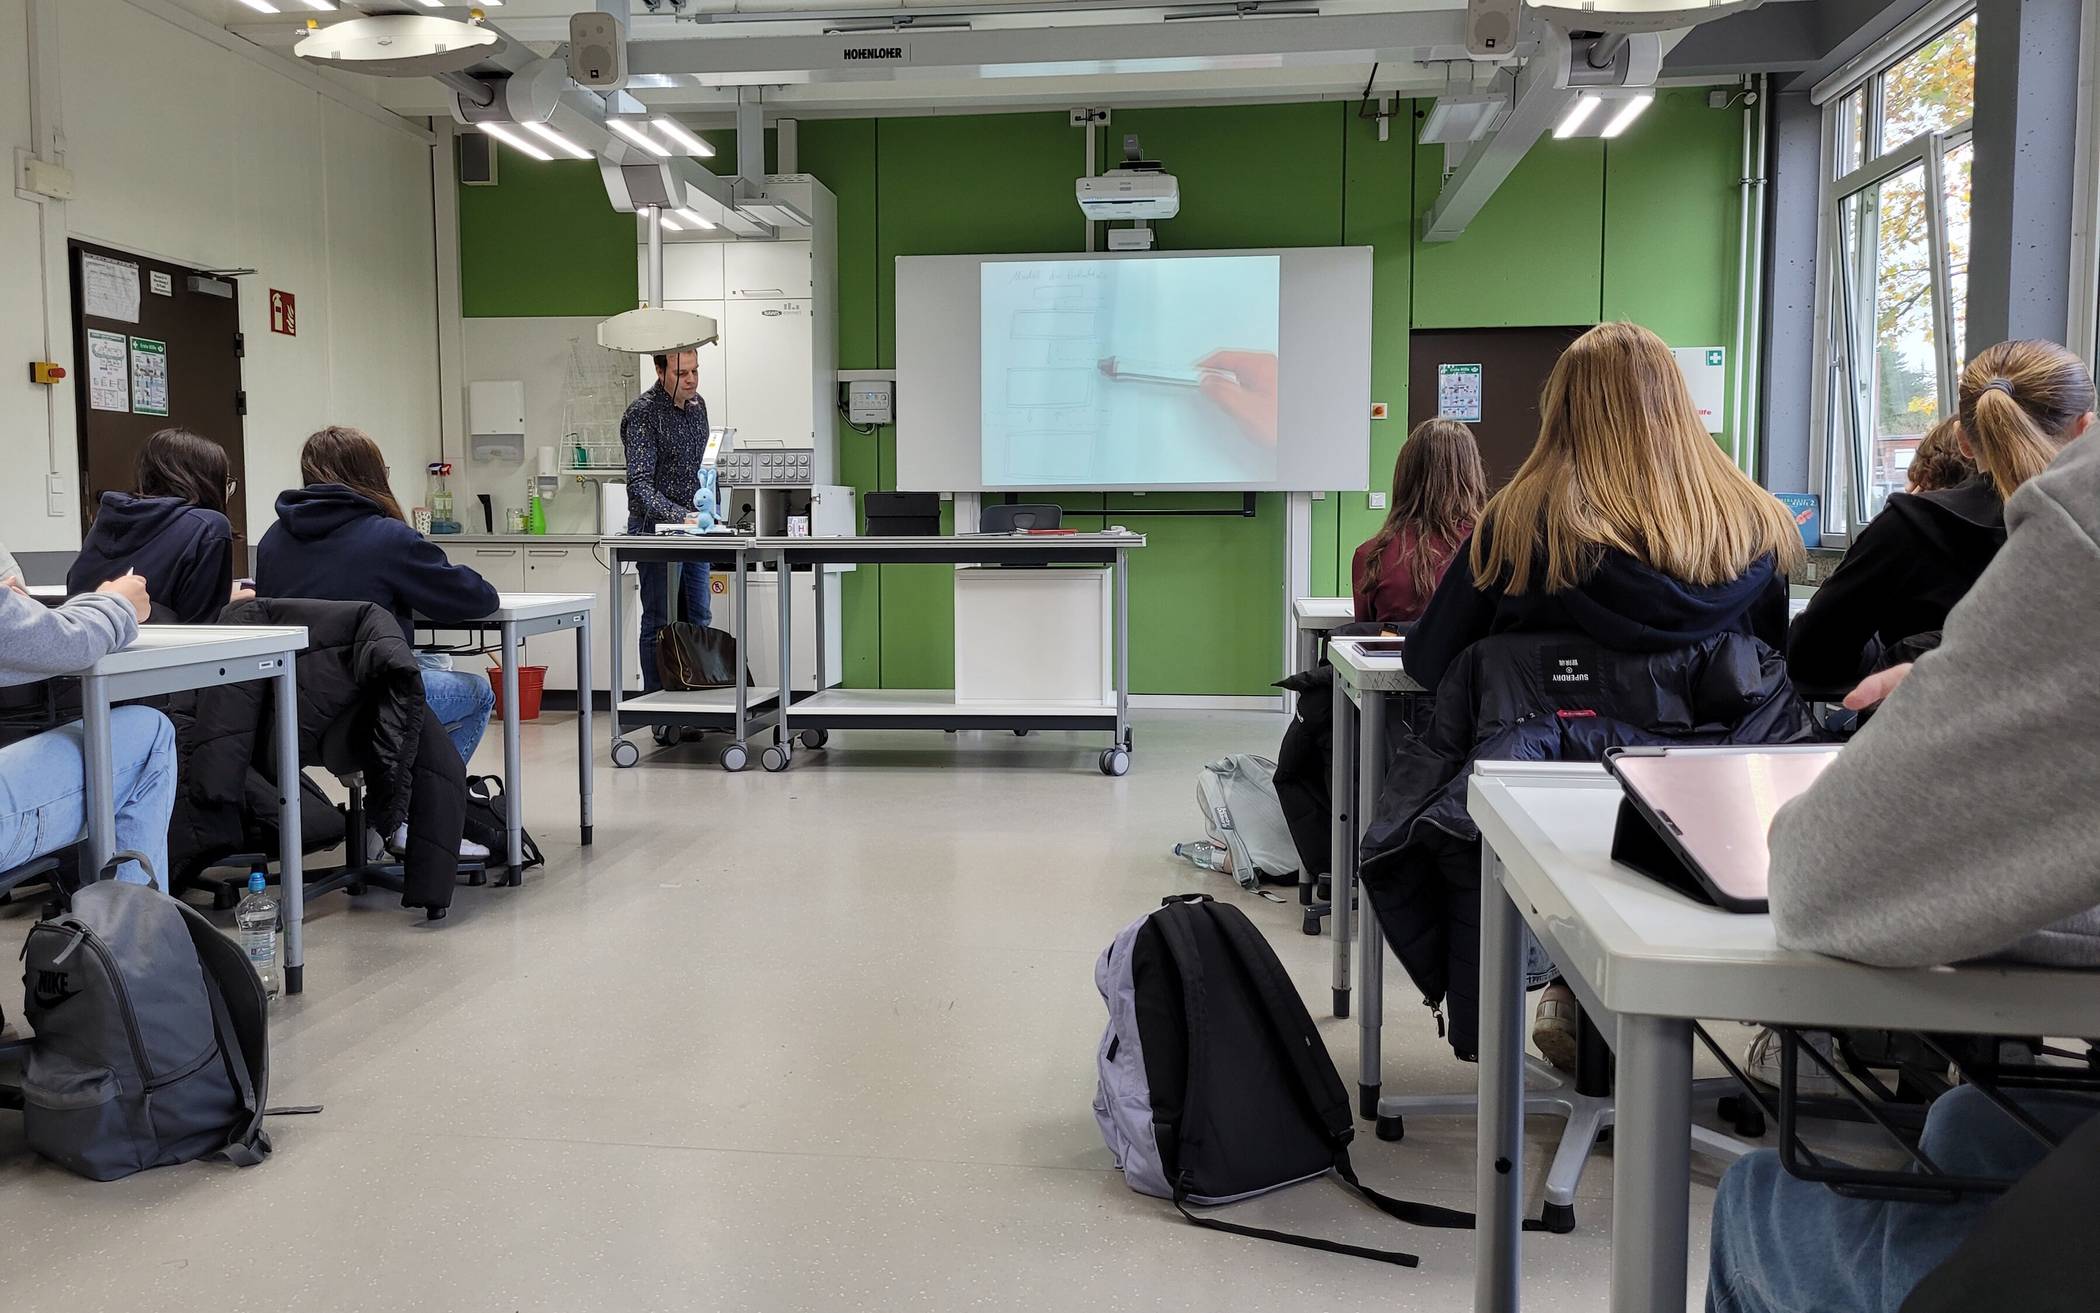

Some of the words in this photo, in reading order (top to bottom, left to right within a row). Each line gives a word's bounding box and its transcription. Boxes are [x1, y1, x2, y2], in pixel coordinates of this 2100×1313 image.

[843, 47, 903, 60] HOHENLOHER
[1552, 673, 1589, 682] SUPERDRY
[37, 969, 69, 994] NIKE
